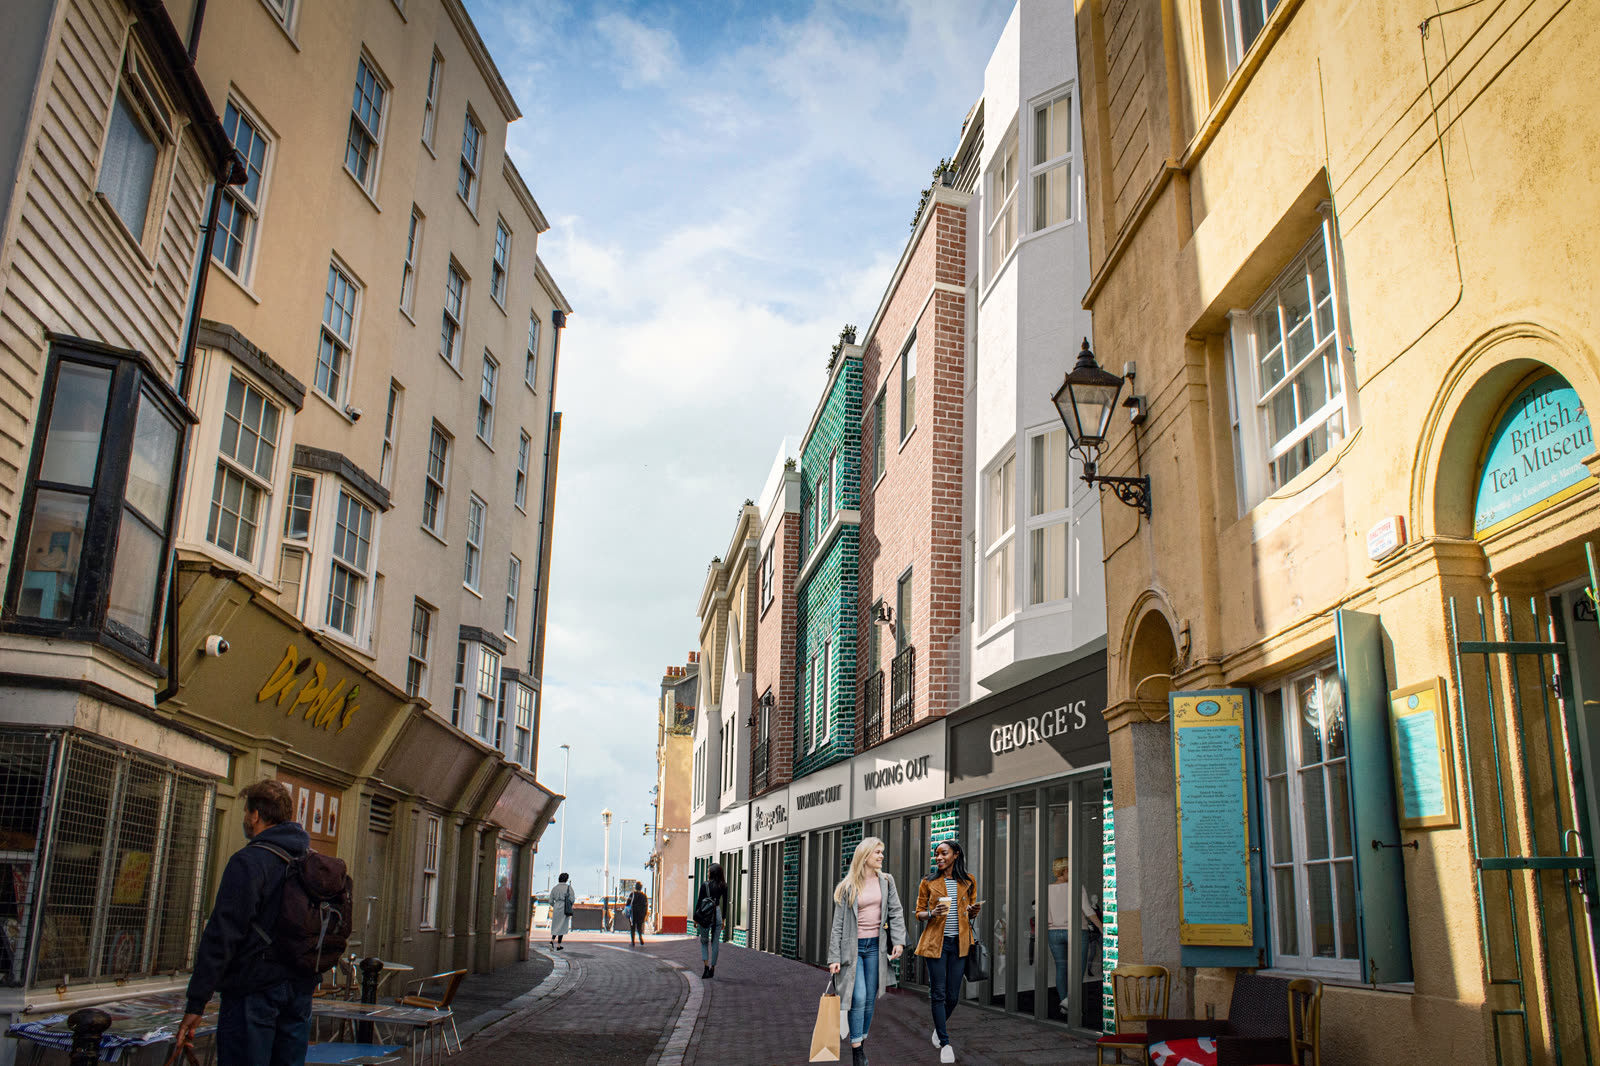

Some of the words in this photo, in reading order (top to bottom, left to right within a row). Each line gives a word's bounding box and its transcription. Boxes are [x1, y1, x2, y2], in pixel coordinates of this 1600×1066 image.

[1519, 387, 1554, 420] The
[1511, 402, 1571, 455] British
[1489, 467, 1518, 493] Tea
[258, 644, 312, 706] Di
[990, 700, 1086, 754] GEORGE'S
[864, 764, 904, 792] WOKING
[906, 754, 930, 781] OUT
[797, 789, 824, 811] WOKING
[825, 784, 842, 803] OUT
